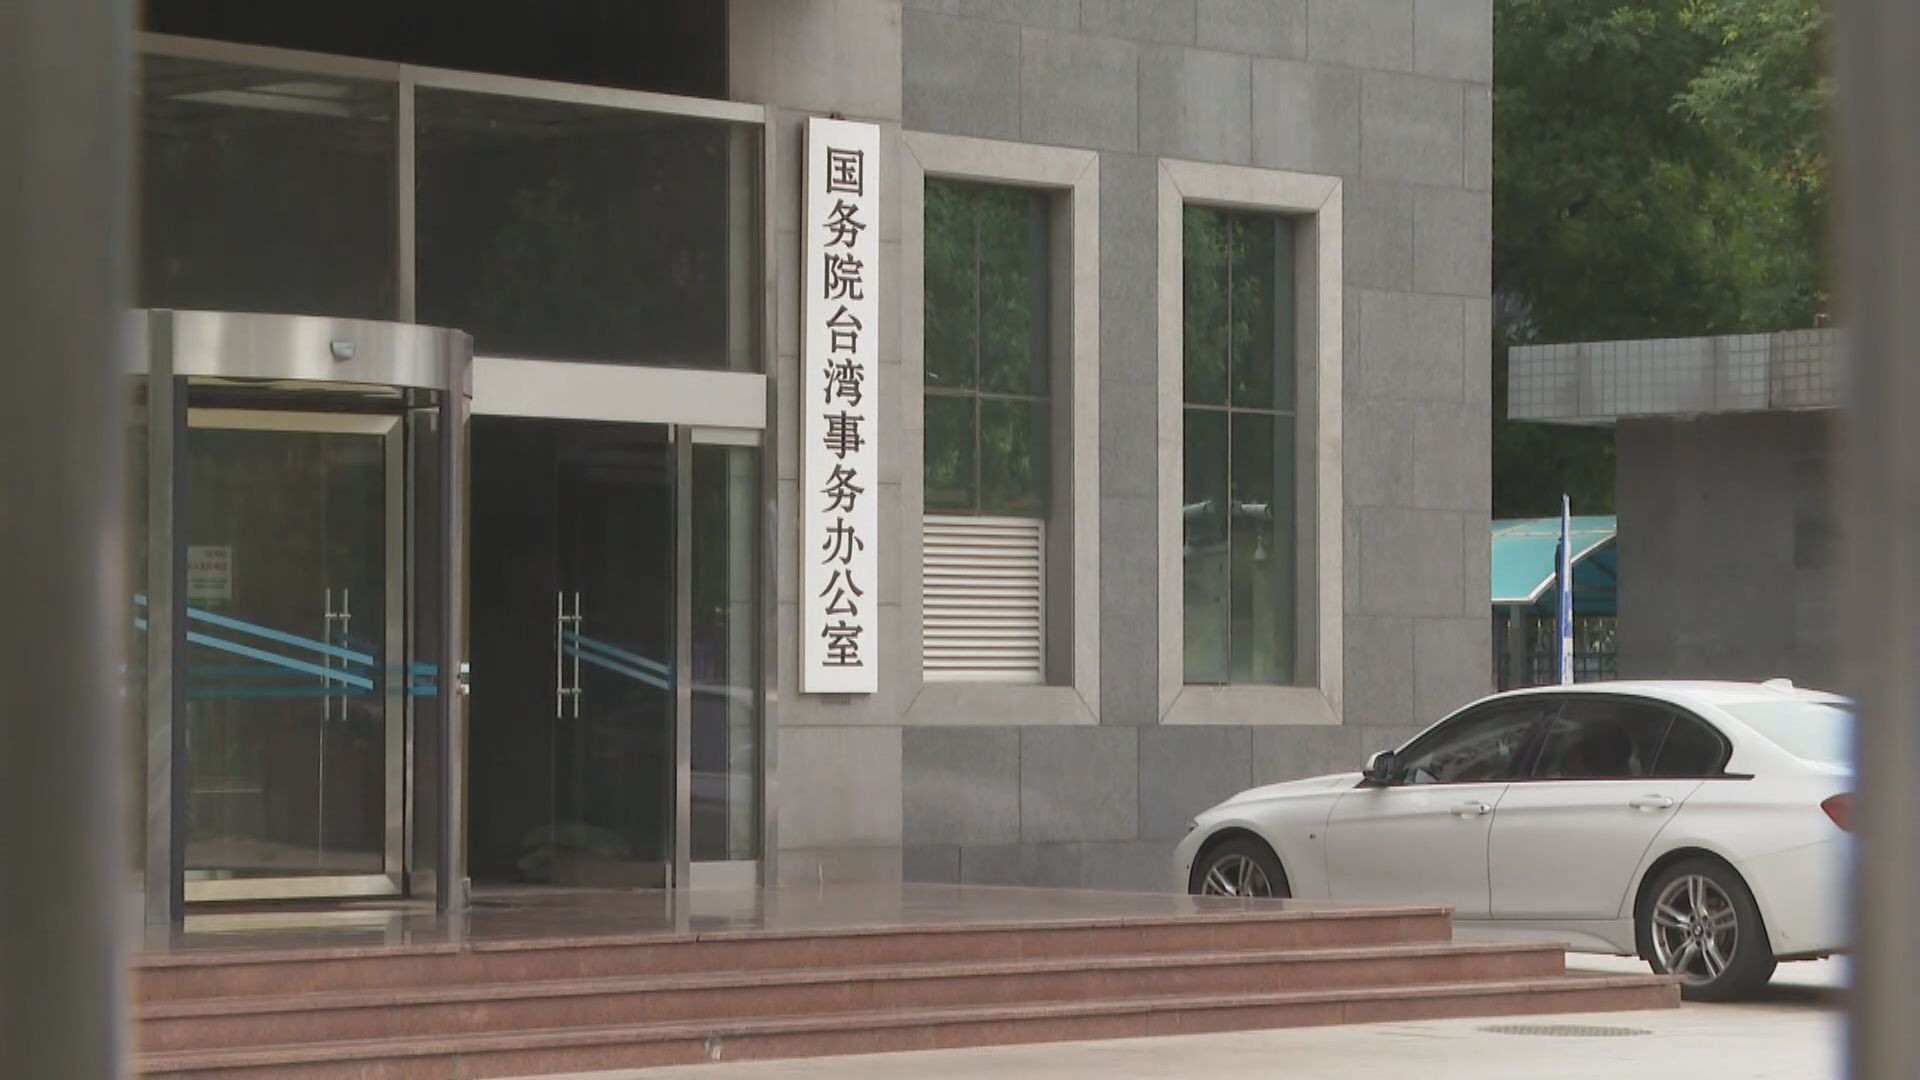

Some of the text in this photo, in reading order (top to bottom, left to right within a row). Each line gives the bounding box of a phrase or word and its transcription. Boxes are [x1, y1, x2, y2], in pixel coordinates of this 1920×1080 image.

[820, 146, 866, 667] 国务院台湾事务办公室
